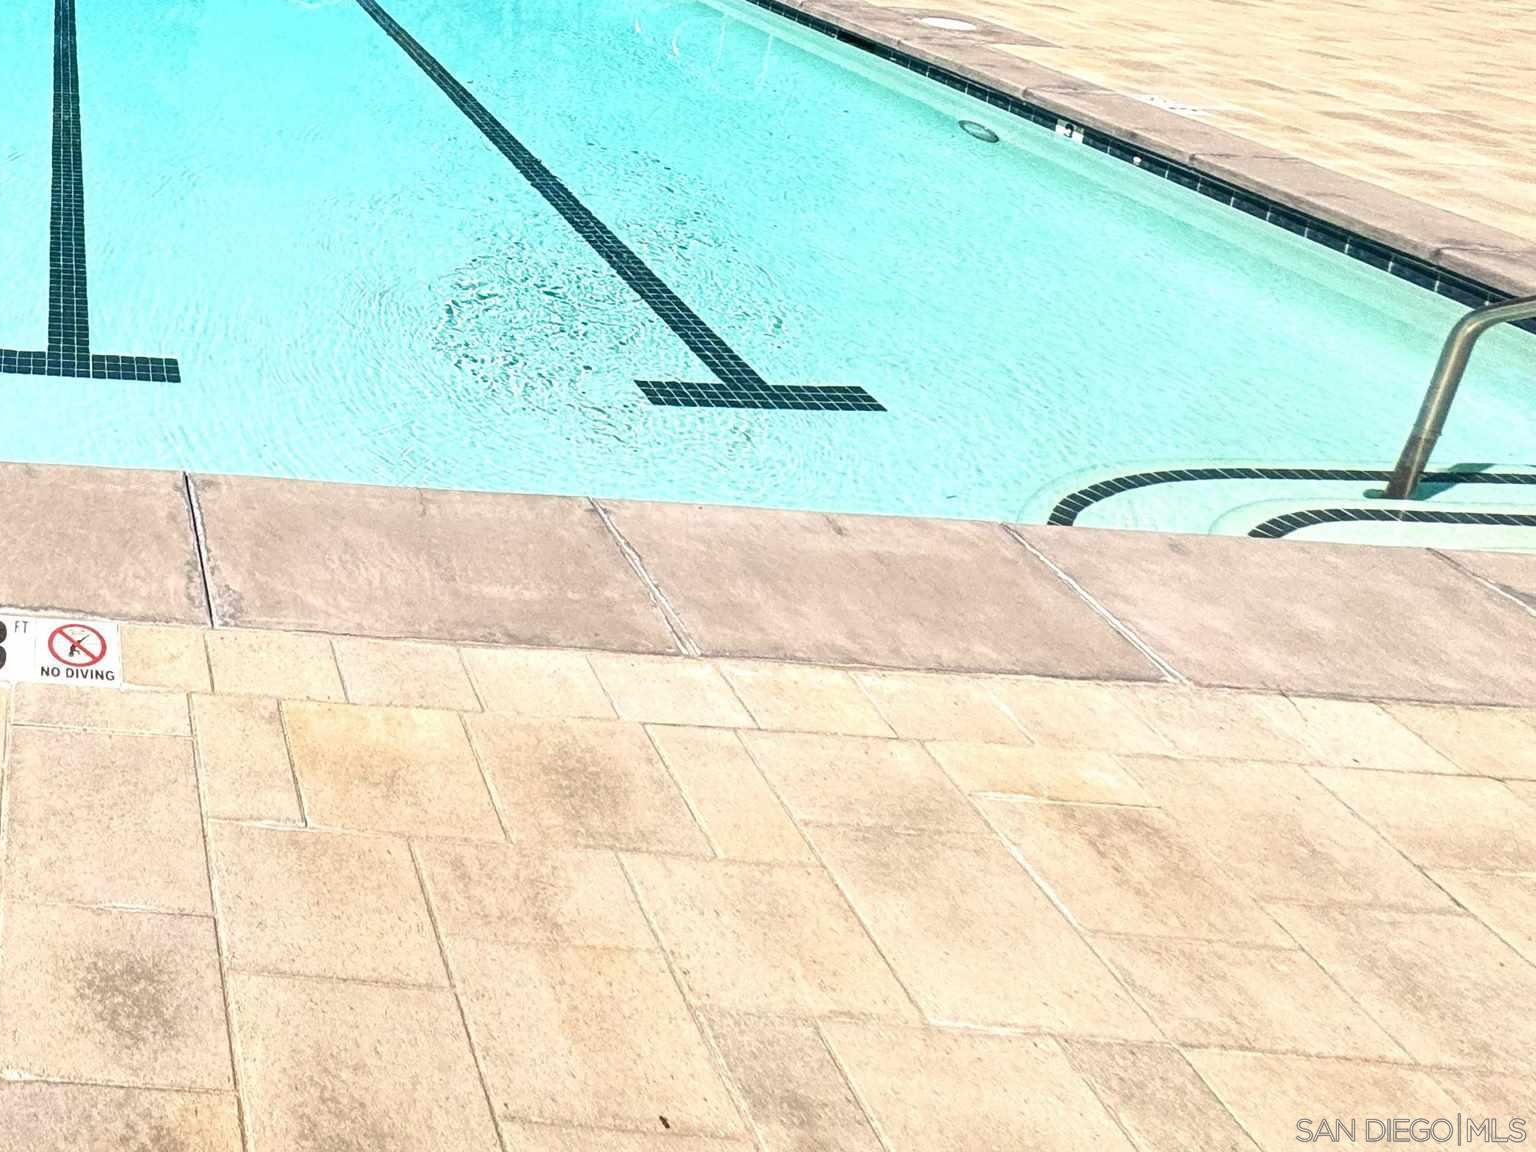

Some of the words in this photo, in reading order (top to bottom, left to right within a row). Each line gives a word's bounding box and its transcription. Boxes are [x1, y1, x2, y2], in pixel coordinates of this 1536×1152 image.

[14, 621, 29, 634] FT
[40, 666, 61, 678] NO
[65, 667, 115, 681] DIVING
